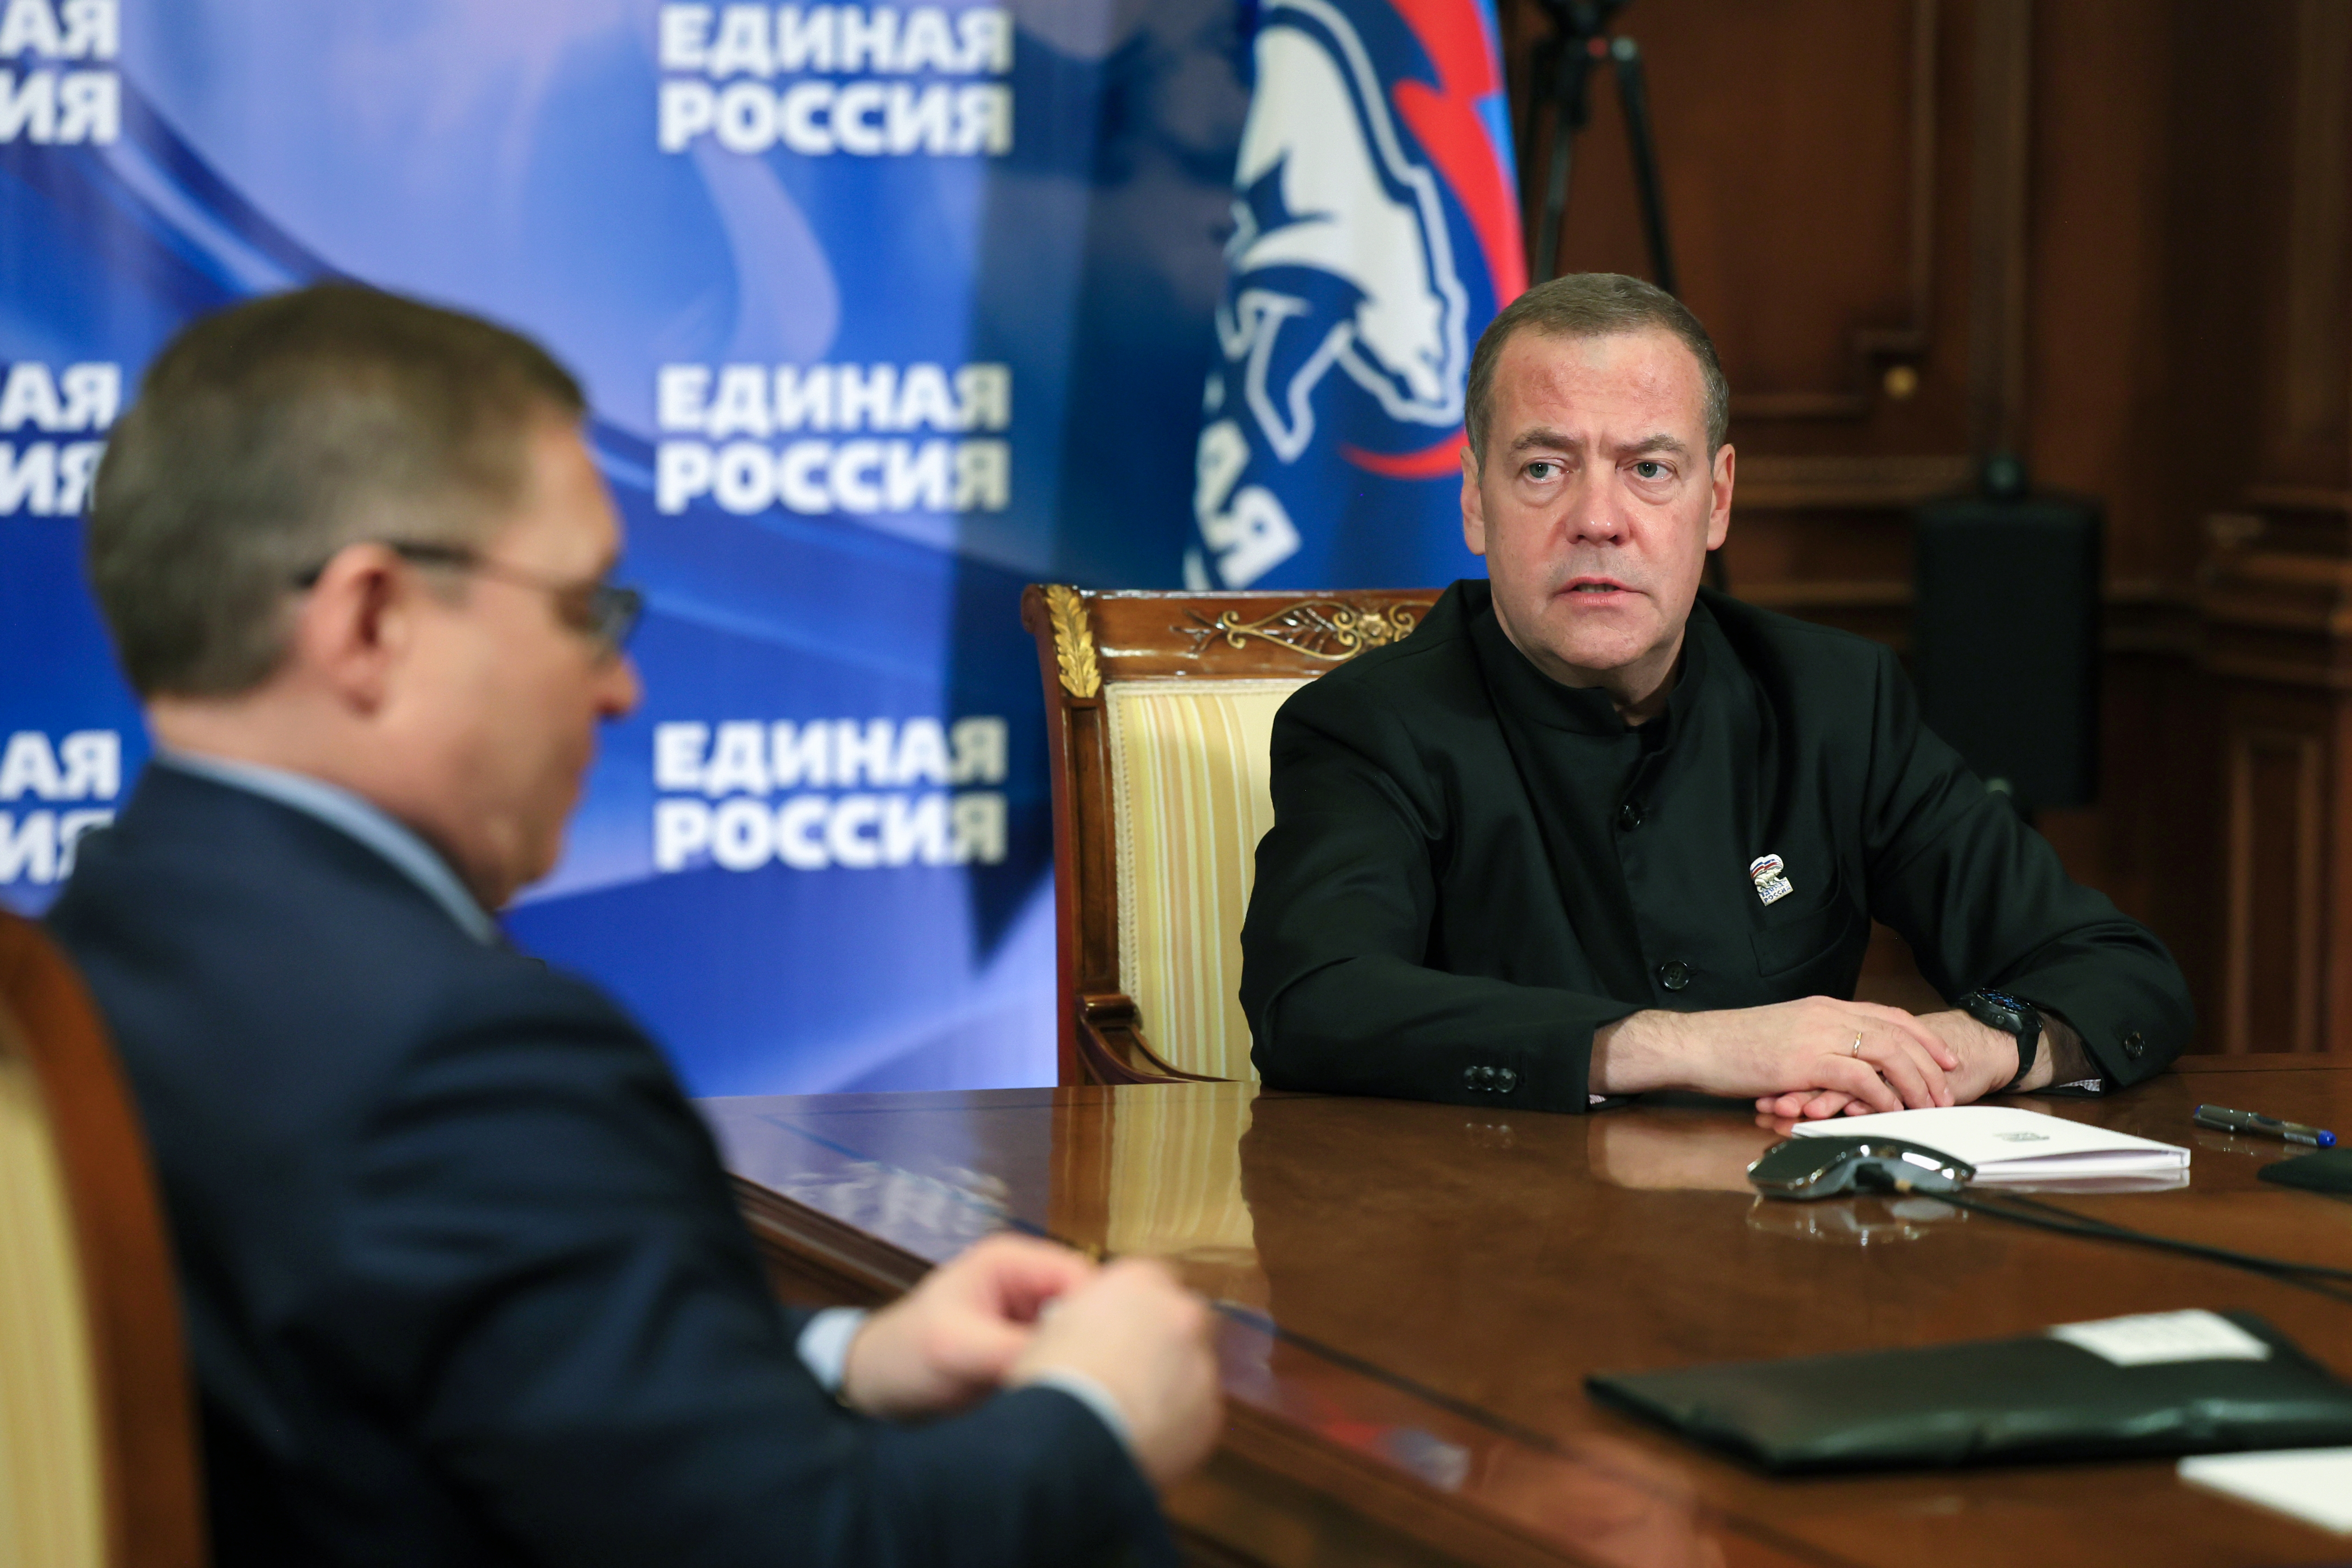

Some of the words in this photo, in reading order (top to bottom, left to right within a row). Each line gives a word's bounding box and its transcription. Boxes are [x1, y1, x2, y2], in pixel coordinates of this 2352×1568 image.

[660, 4, 1014, 78] ЕДИНАЯ
[658, 80, 1014, 155] РОССИЯ
[657, 362, 1012, 438] ЕДИНАЯ
[655, 439, 1011, 515] РОССИЯ
[654, 716, 1009, 796] ЕДИНАЯ
[654, 791, 1009, 872] РОССИЯ
[1760, 879, 1788, 897] ДИНА
[1764, 885, 1791, 903] РОССИЯ
